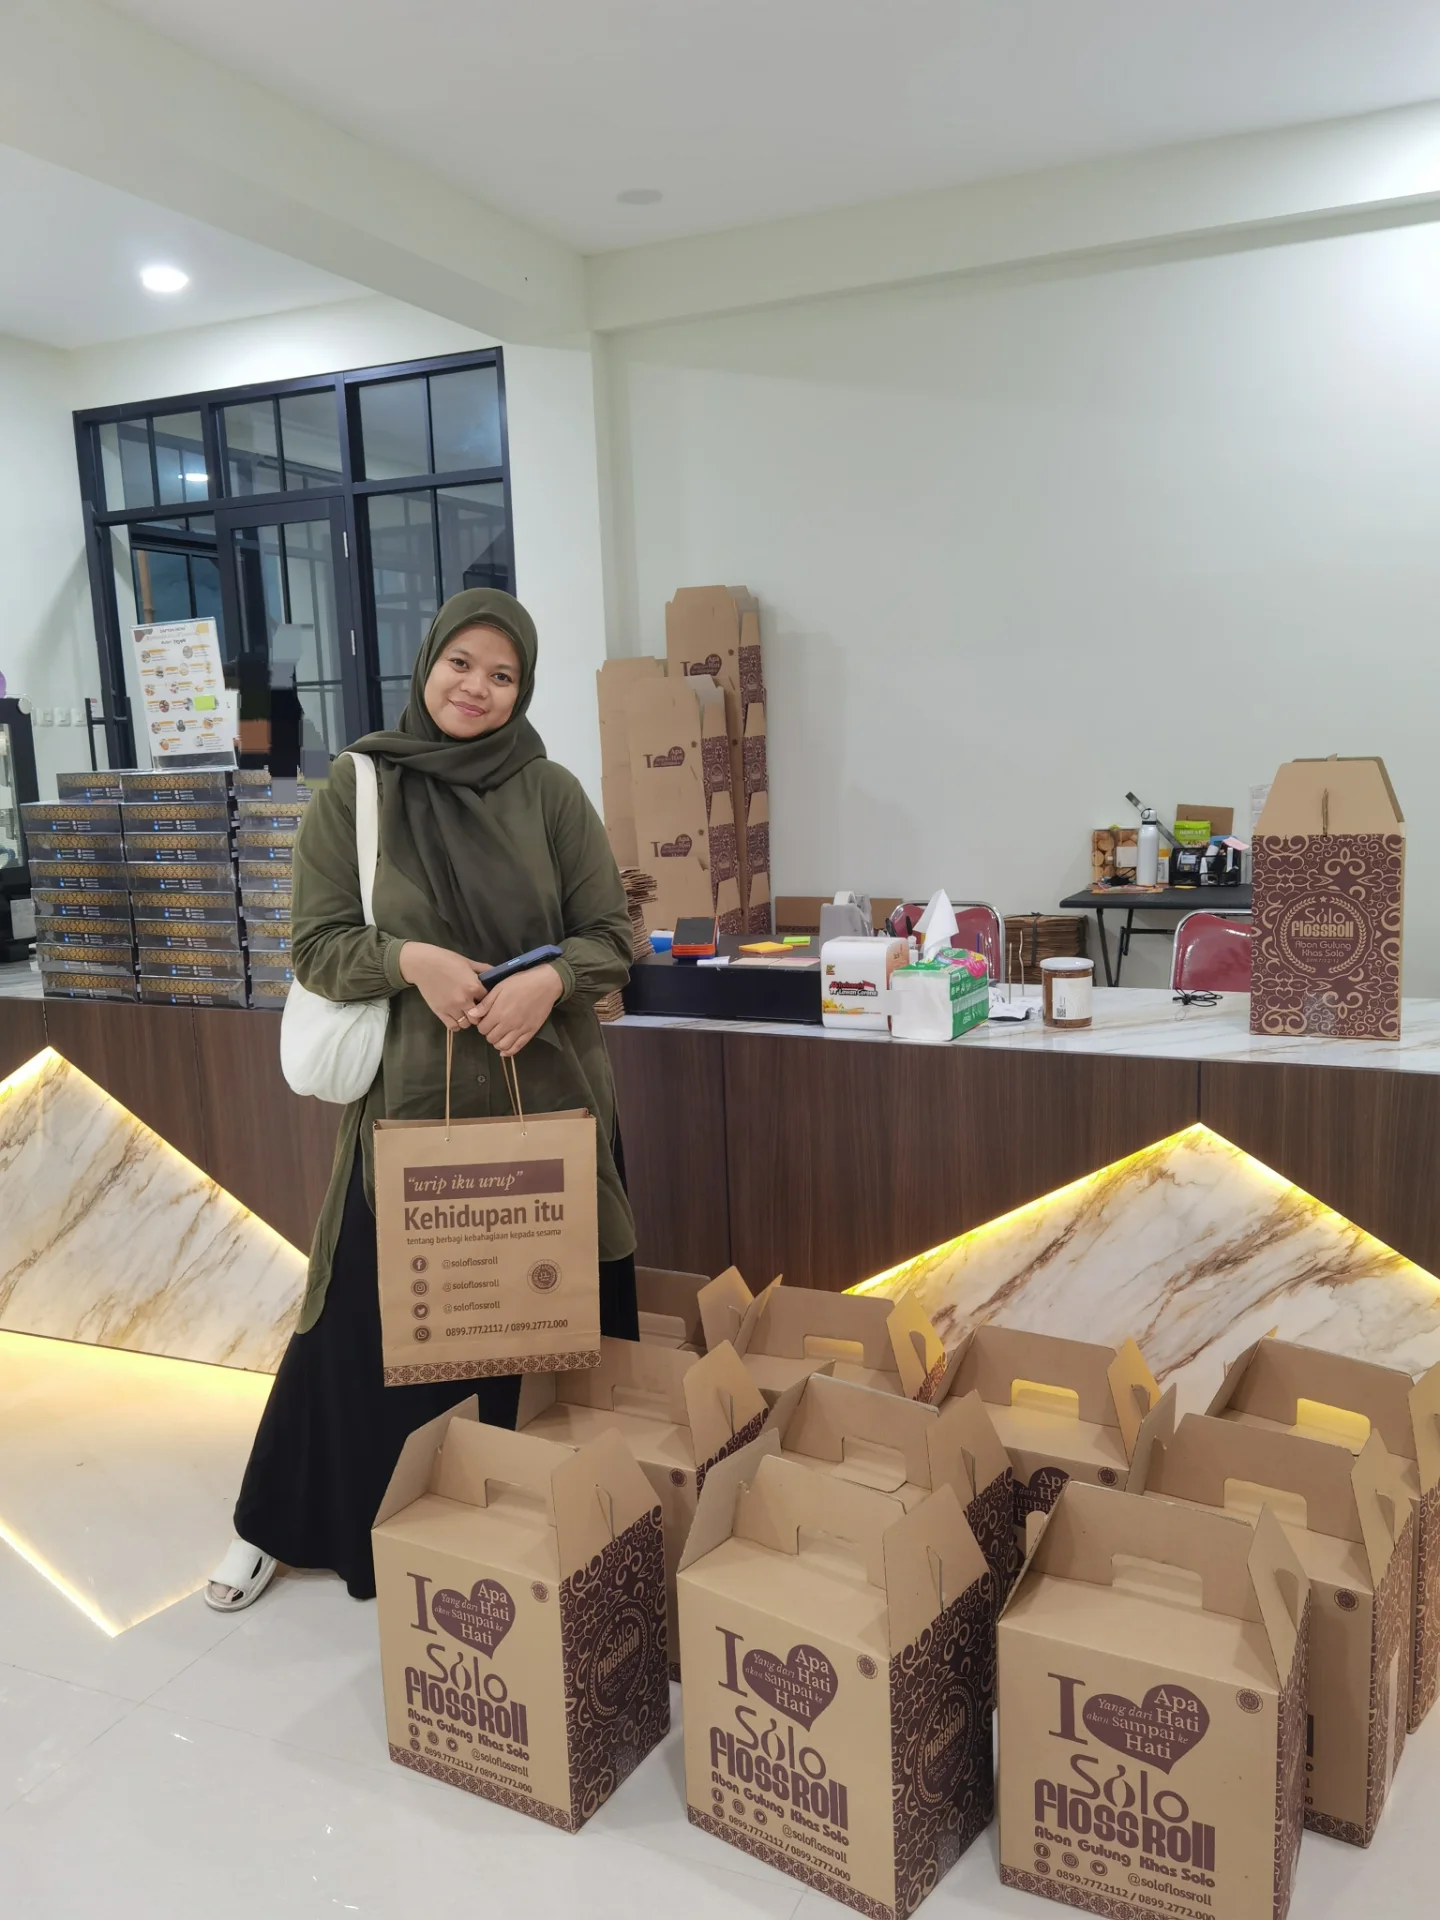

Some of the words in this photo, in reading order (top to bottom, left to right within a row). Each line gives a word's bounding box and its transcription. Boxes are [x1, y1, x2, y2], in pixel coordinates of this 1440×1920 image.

[1302, 949, 1323, 957] Khas
[1325, 949, 1345, 957] Solo
[1320, 940, 1352, 951] Gulung
[451, 1174, 475, 1190] iku
[404, 1204, 527, 1232] Kehidupan
[535, 1199, 564, 1222] itu
[407, 1237, 435, 1246] tentang
[436, 1235, 463, 1245] berbagi
[464, 1232, 509, 1242] kebahagiaan
[510, 1230, 535, 1240] kepada
[536, 1228, 562, 1236] sesama
[1039, 1486, 1060, 1501] Ha
[406, 1571, 438, 1635] I
[441, 1593, 461, 1608] Yang
[480, 1600, 510, 1622] Hati
[478, 1583, 508, 1604] Apa
[451, 1609, 495, 1630] sampai
[460, 1622, 494, 1646] Hati
[715, 1625, 748, 1698] I
[753, 1653, 775, 1672] Yang
[797, 1666, 832, 1693] Hati
[795, 1648, 830, 1675] Apa
[764, 1672, 813, 1700] sampai
[1154, 1688, 1199, 1713] Apa
[774, 1687, 811, 1717] Hati
[1047, 1672, 1088, 1745] I
[1098, 1698, 1126, 1716] Yang
[1128, 1705, 1153, 1721] dari
[1156, 1707, 1200, 1733] Hati
[408, 1708, 433, 1726] Abon
[436, 1719, 473, 1743] Gulung
[478, 1733, 504, 1752] Khas
[506, 1743, 530, 1761] Solo
[1086, 1712, 1109, 1724] akan
[1112, 1716, 1176, 1741] sampai
[1177, 1733, 1189, 1744] ke
[1125, 1732, 1172, 1760] Hati
[471, 1748, 529, 1777] @soloflossroll
[711, 1771, 740, 1795] Abon
[743, 1787, 785, 1818] Gulung
[790, 1808, 820, 1832] Khas
[822, 1824, 849, 1846] Solo
[783, 1824, 848, 1864] @soloflossroll
[1034, 1825, 1072, 1847] Abon
[1077, 1839, 1132, 1868] Gulung
[1139, 1855, 1178, 1878] Khas
[1181, 1868, 1216, 1888] Solo
[1056, 1869, 1129, 1900] 0899.777.2112
[1127, 1872, 1213, 1906] @soloflossroll
